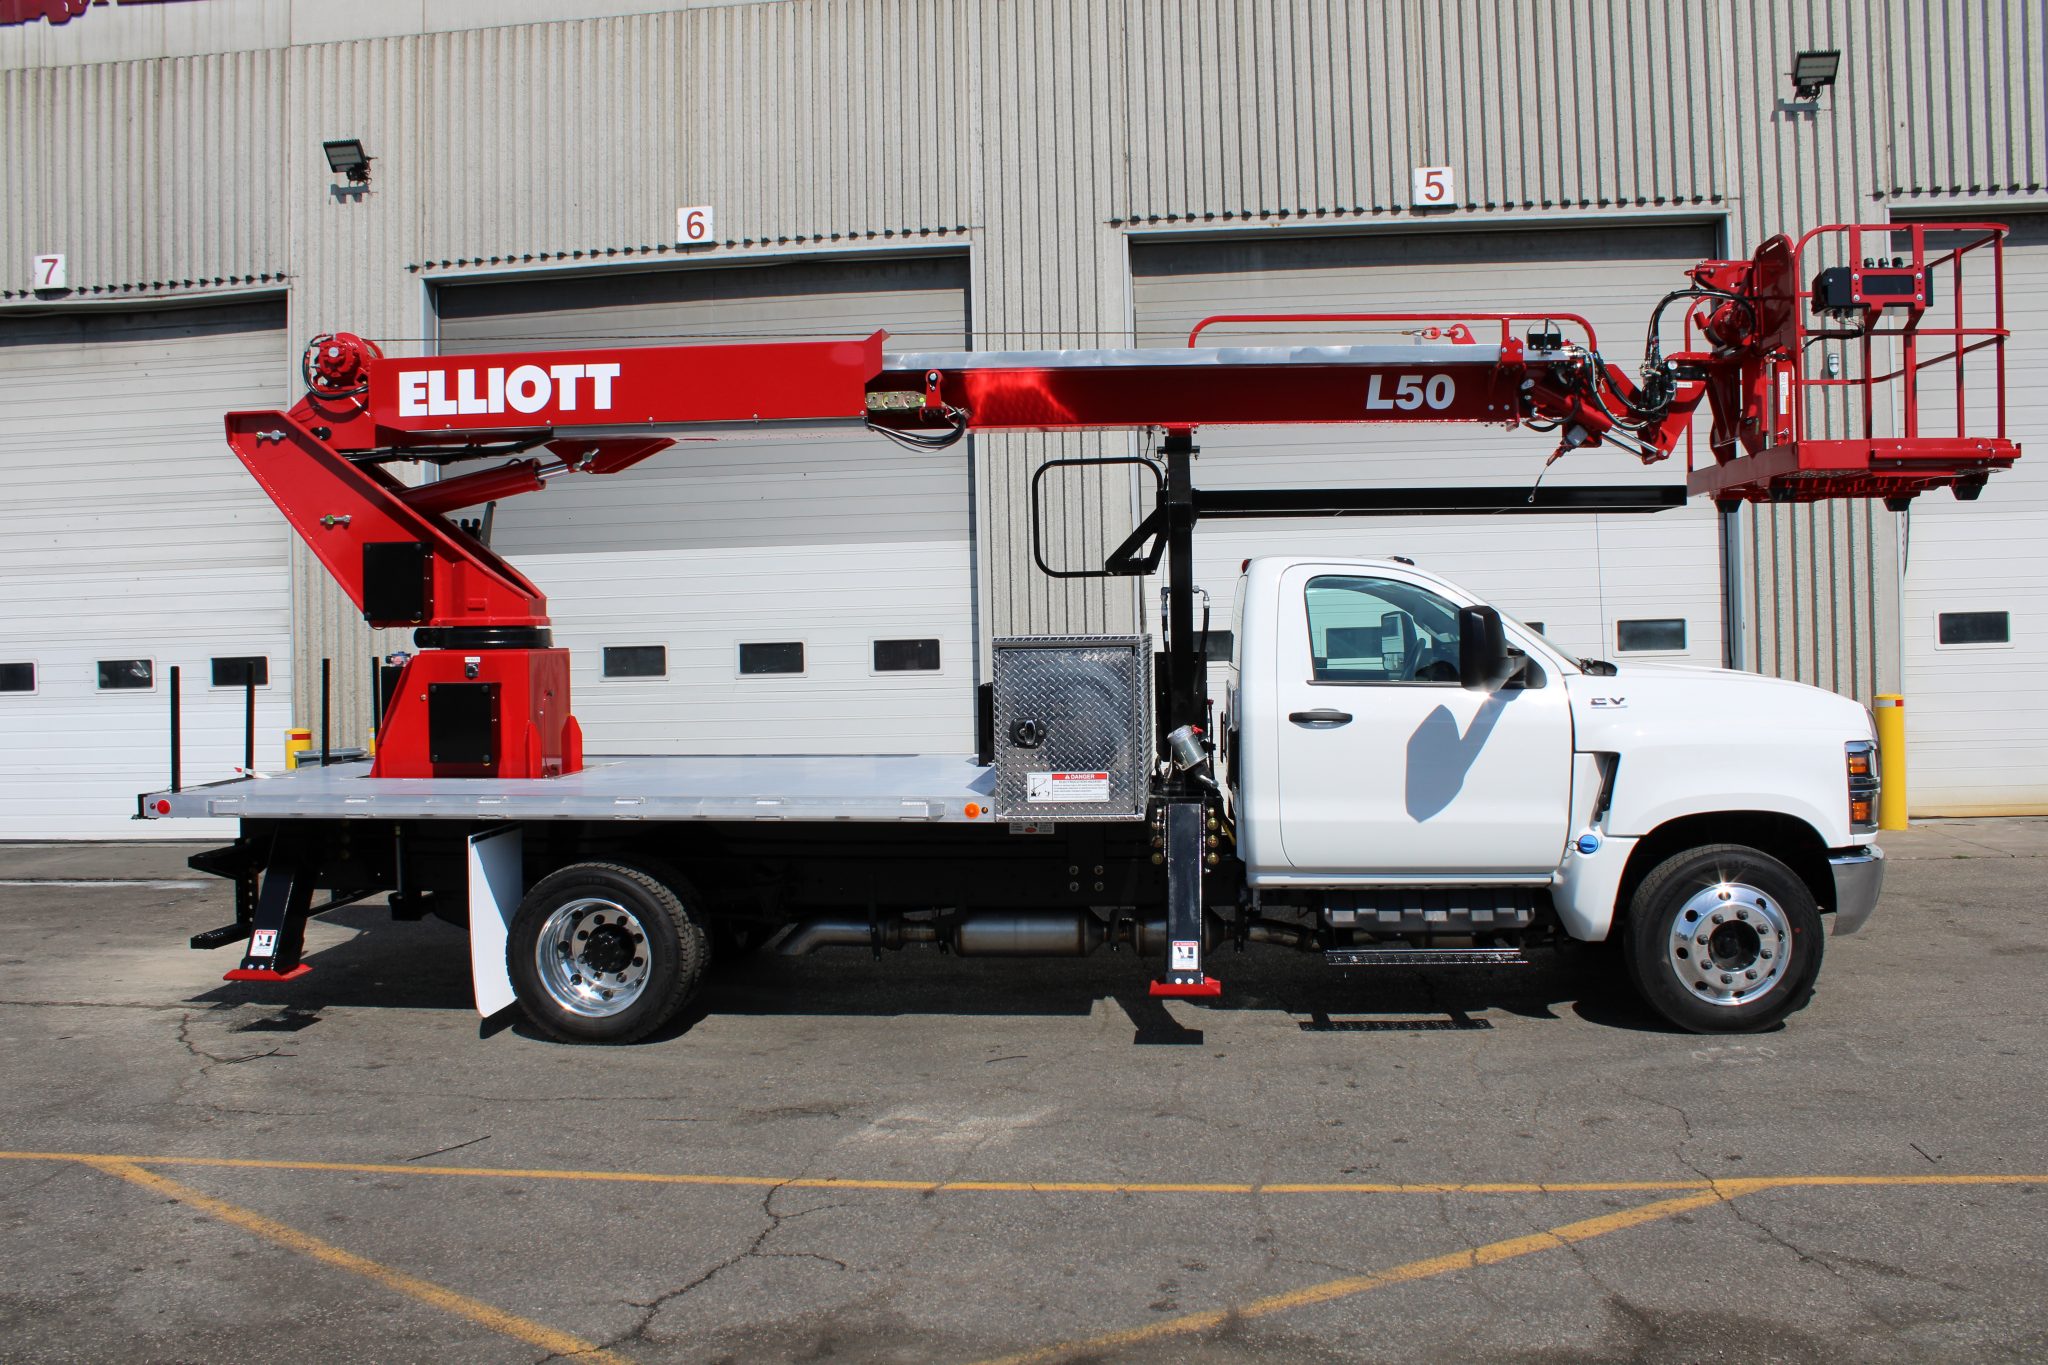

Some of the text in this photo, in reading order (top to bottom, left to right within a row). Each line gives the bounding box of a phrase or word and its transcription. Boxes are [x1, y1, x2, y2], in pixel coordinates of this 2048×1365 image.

[1424, 171, 1445, 201] 5
[687, 211, 705, 240] 6
[41, 258, 58, 285] 7
[398, 363, 621, 417] ELLIOTT
[1366, 374, 1456, 411] L50
